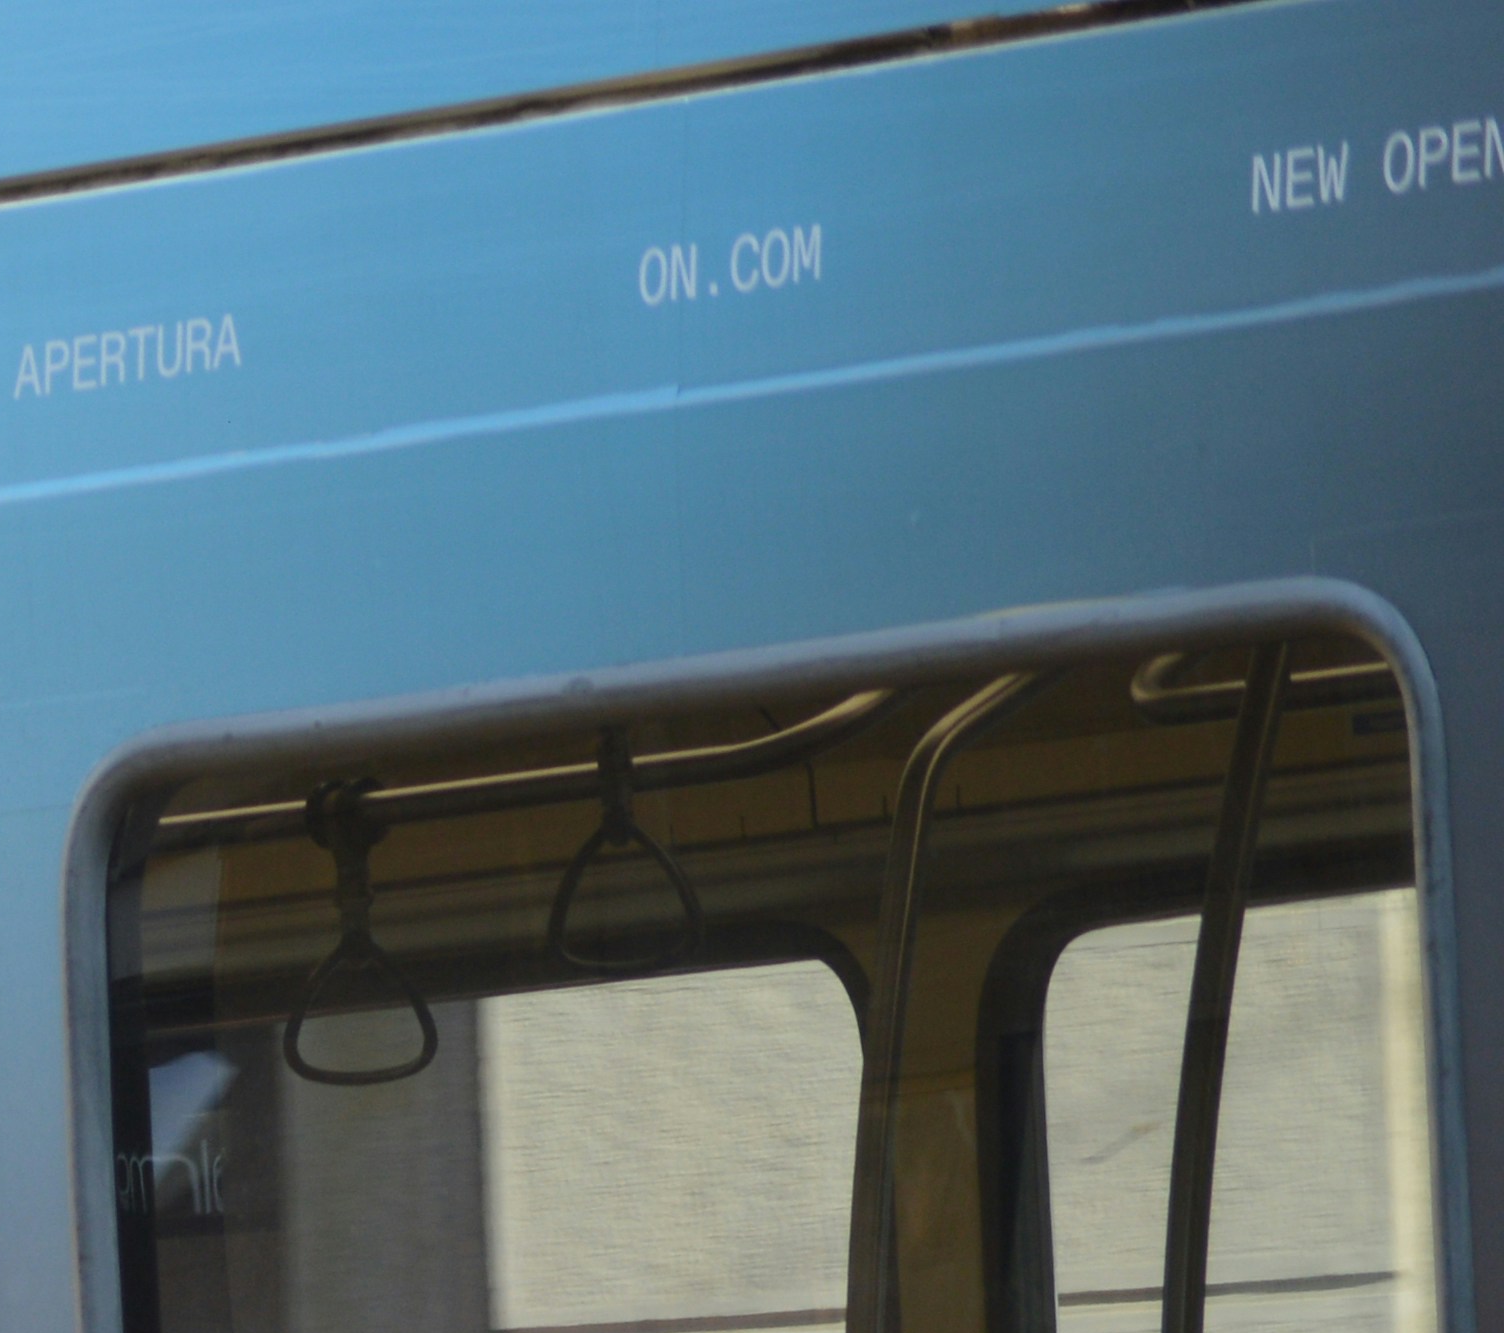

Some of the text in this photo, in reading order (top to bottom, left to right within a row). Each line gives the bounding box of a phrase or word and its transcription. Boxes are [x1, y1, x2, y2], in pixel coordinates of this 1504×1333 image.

[1252, 140, 1349, 213] NEW
[639, 225, 822, 306] ON.COM
[14, 314, 242, 399] APERTURA
